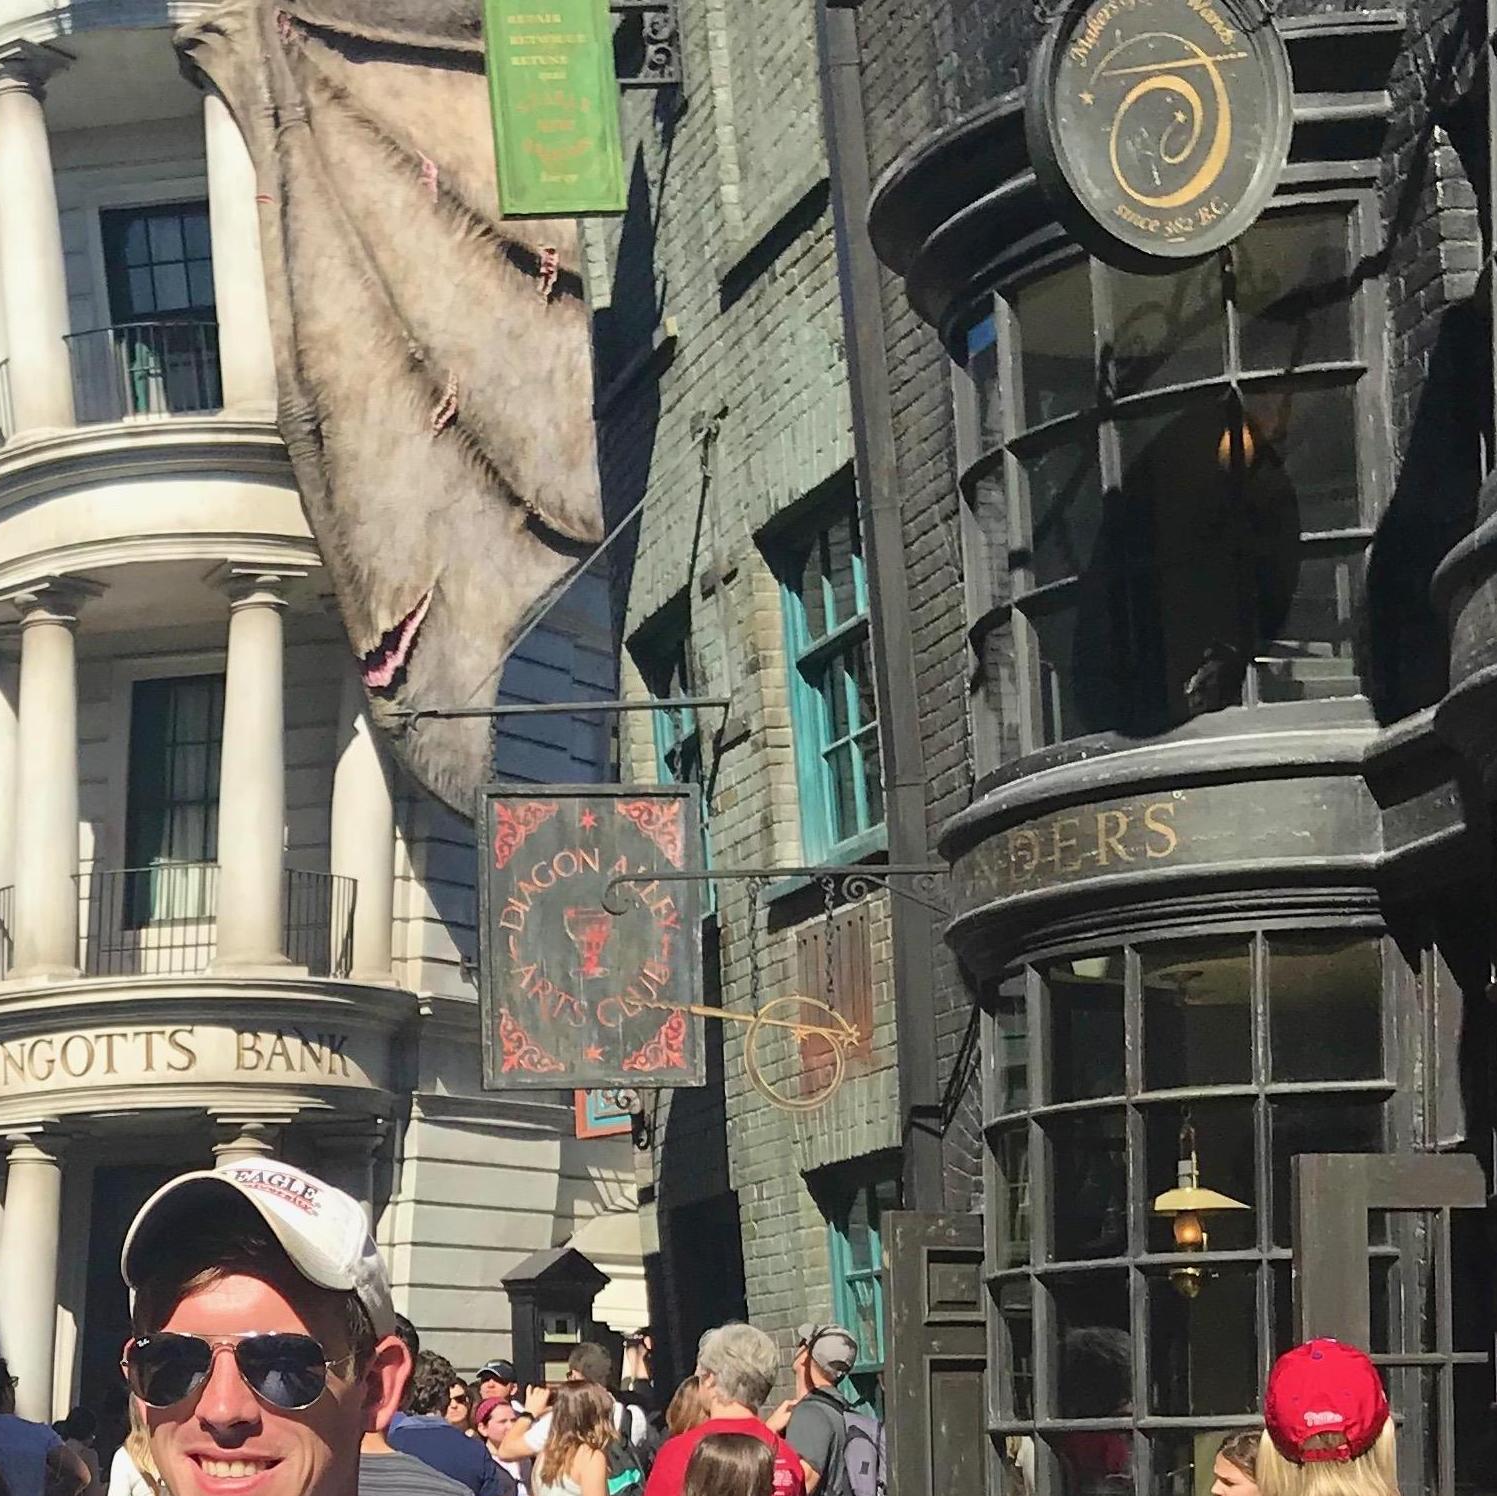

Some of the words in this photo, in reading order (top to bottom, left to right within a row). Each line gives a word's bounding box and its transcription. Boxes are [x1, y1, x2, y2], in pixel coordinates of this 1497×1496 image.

[499, 847, 600, 932] DIAGON
[607, 854, 681, 931] ALLEY
[510, 961, 588, 1028] ARTS
[596, 959, 671, 1028] CLUB
[234, 1027, 352, 1079] BANK
[234, 1169, 318, 1203] EAGLE
